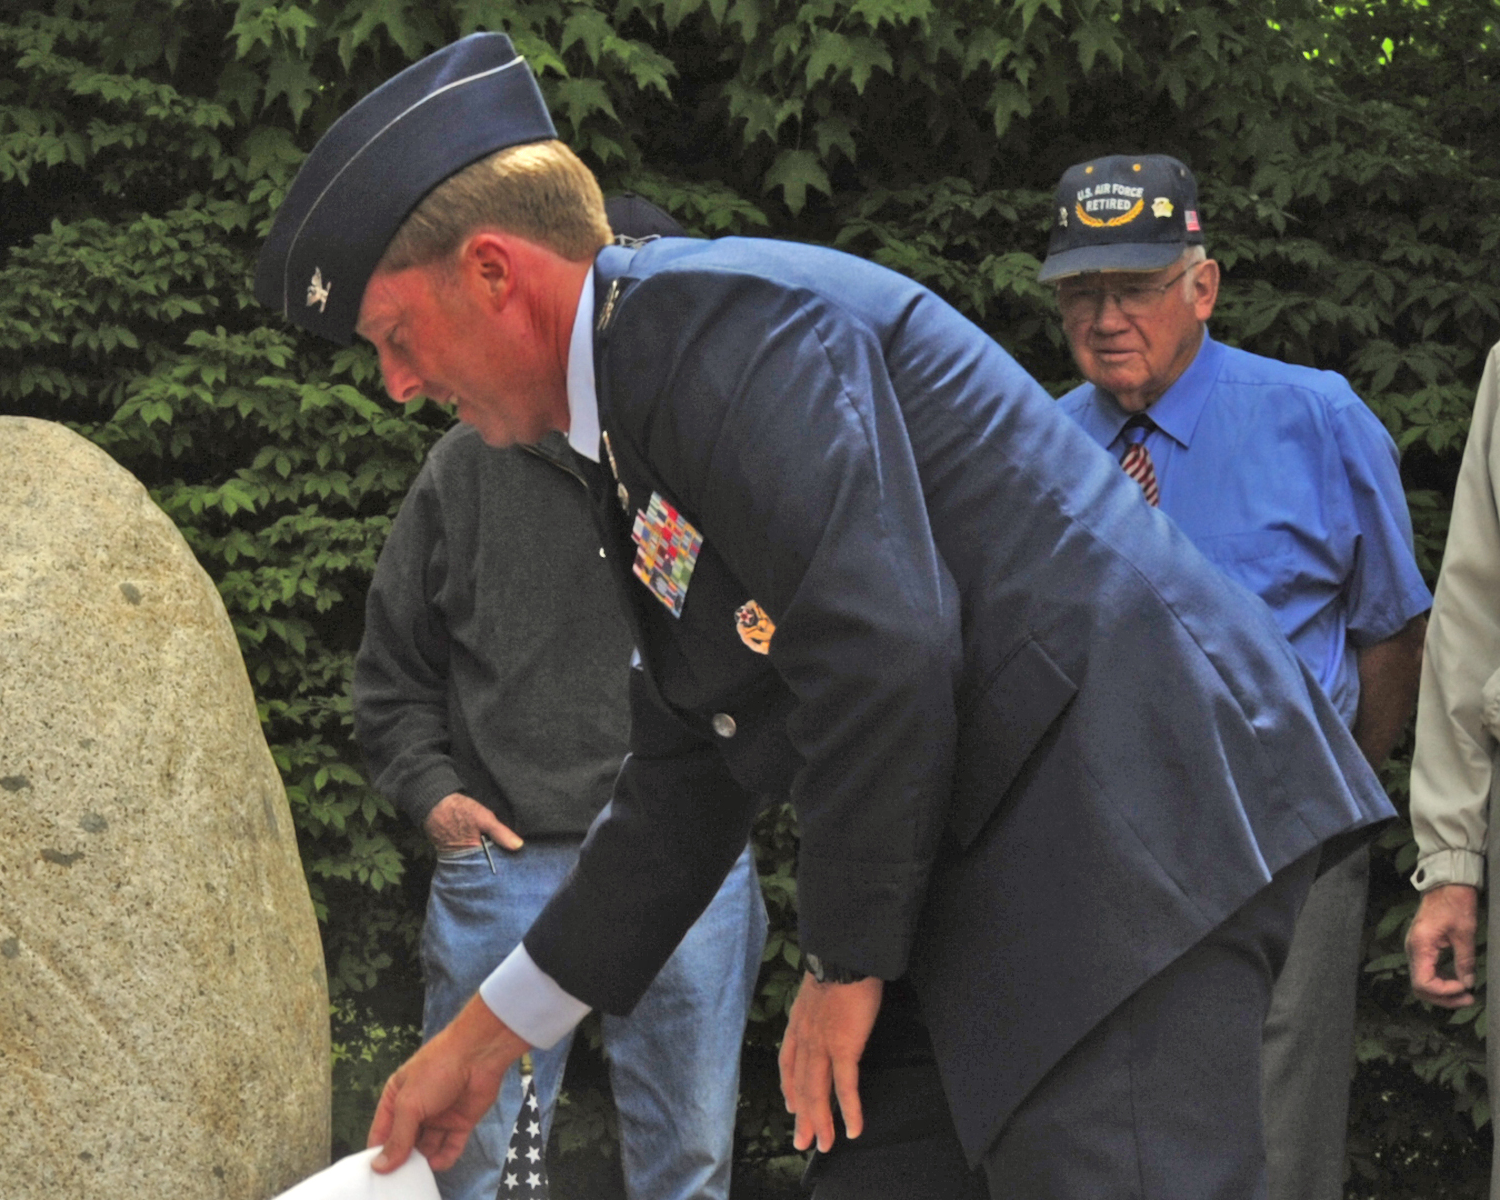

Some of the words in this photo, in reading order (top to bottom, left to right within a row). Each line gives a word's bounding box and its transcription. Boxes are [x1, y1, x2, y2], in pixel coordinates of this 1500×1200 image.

[1077, 187, 1093, 201] U.S.
[1094, 183, 1111, 195] AIR
[1112, 183, 1144, 198] FORCE
[1086, 198, 1131, 212] RETIRED
